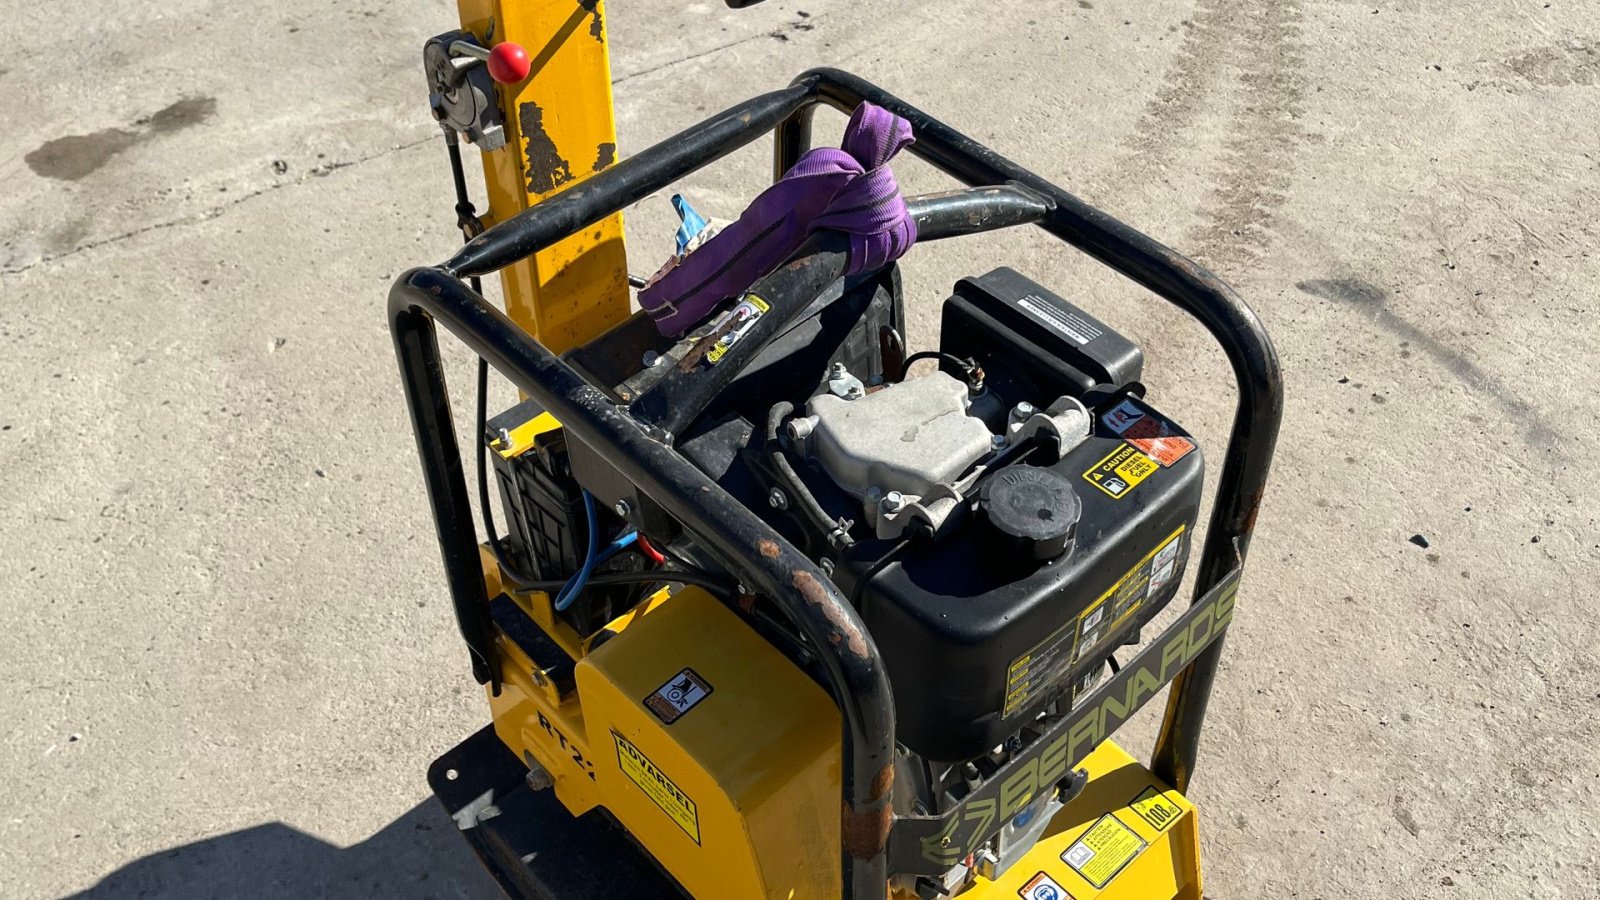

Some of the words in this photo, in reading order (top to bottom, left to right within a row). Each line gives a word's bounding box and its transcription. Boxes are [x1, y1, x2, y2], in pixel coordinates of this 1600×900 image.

[1103, 446, 1135, 472] CAUTION
[1120, 455, 1144, 472] DIESEL
[1130, 461, 1147, 474] FUEL
[1136, 464, 1152, 478] ONLY
[1000, 579, 1240, 822] BERNARDS
[619, 738, 695, 815] ADVARSEL
[1145, 803, 1171, 826] 108
